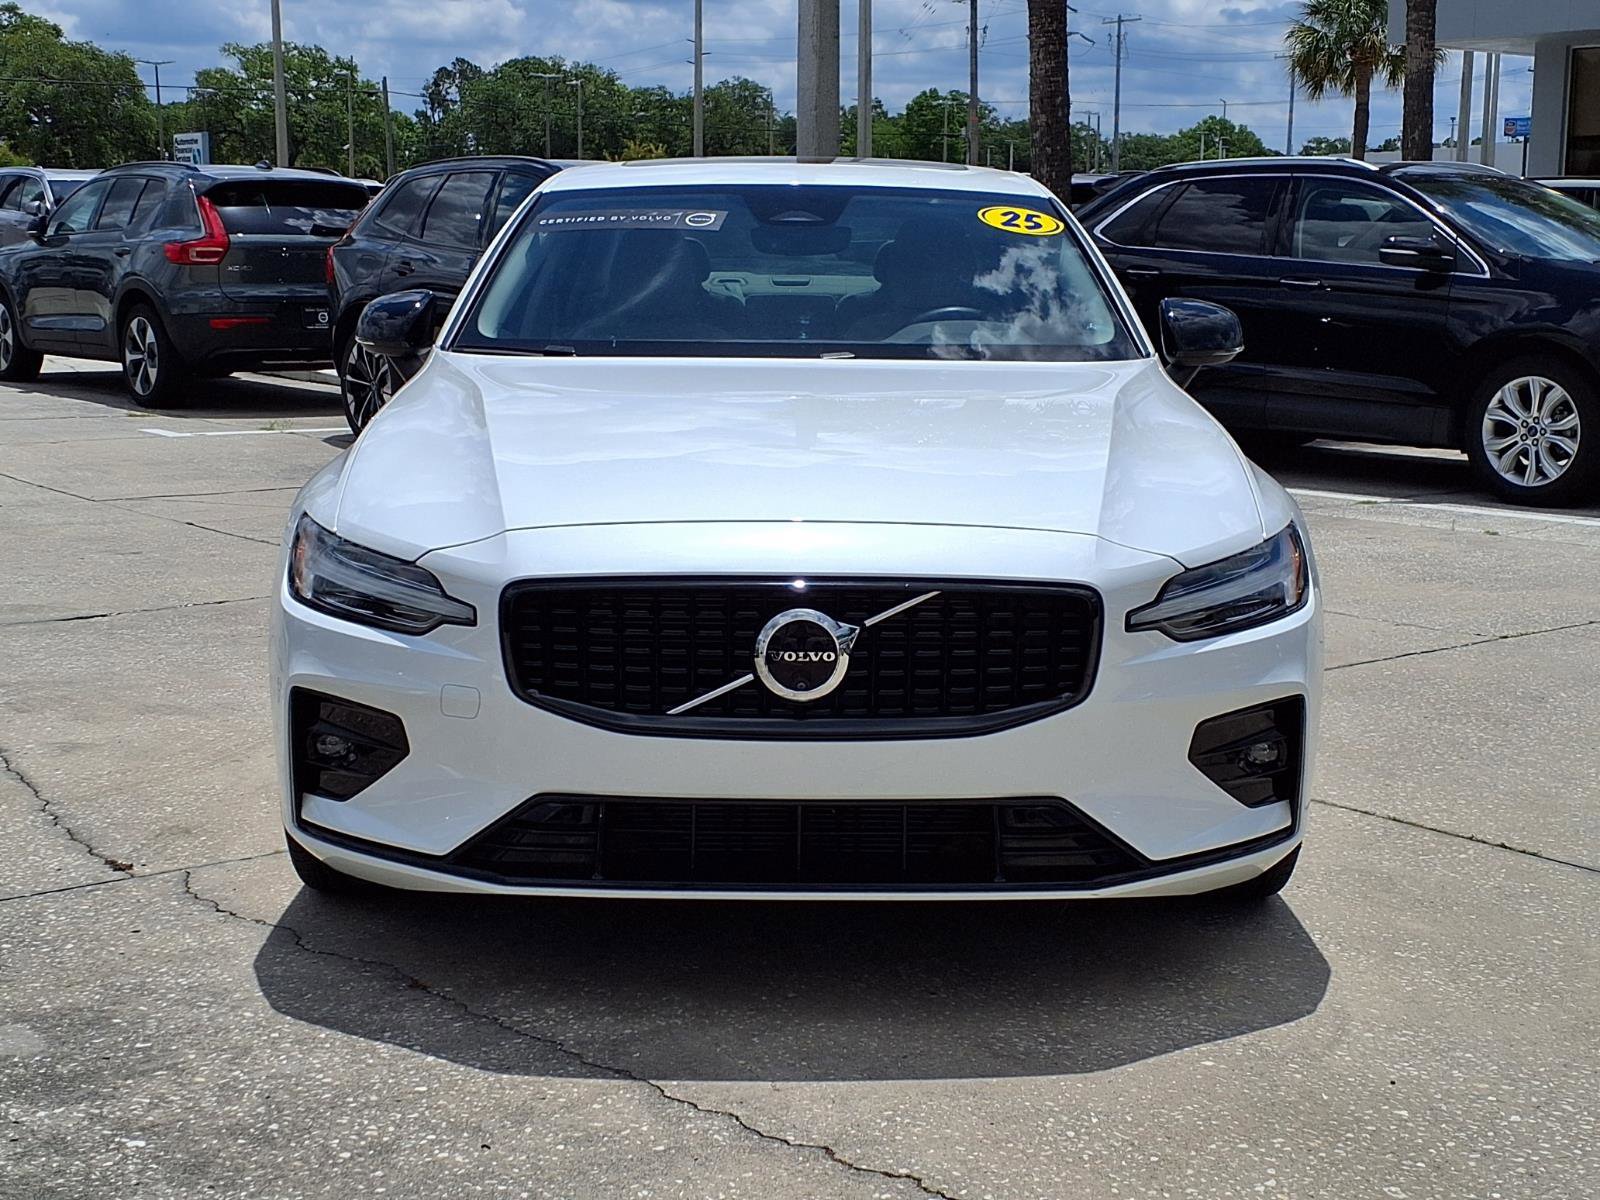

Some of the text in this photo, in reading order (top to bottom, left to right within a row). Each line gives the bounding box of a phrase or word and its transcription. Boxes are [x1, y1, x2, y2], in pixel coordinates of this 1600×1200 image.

[540, 216, 605, 225] CERTIFIED
[1001, 211, 1042, 230] 25
[768, 651, 836, 662] VOLVO
